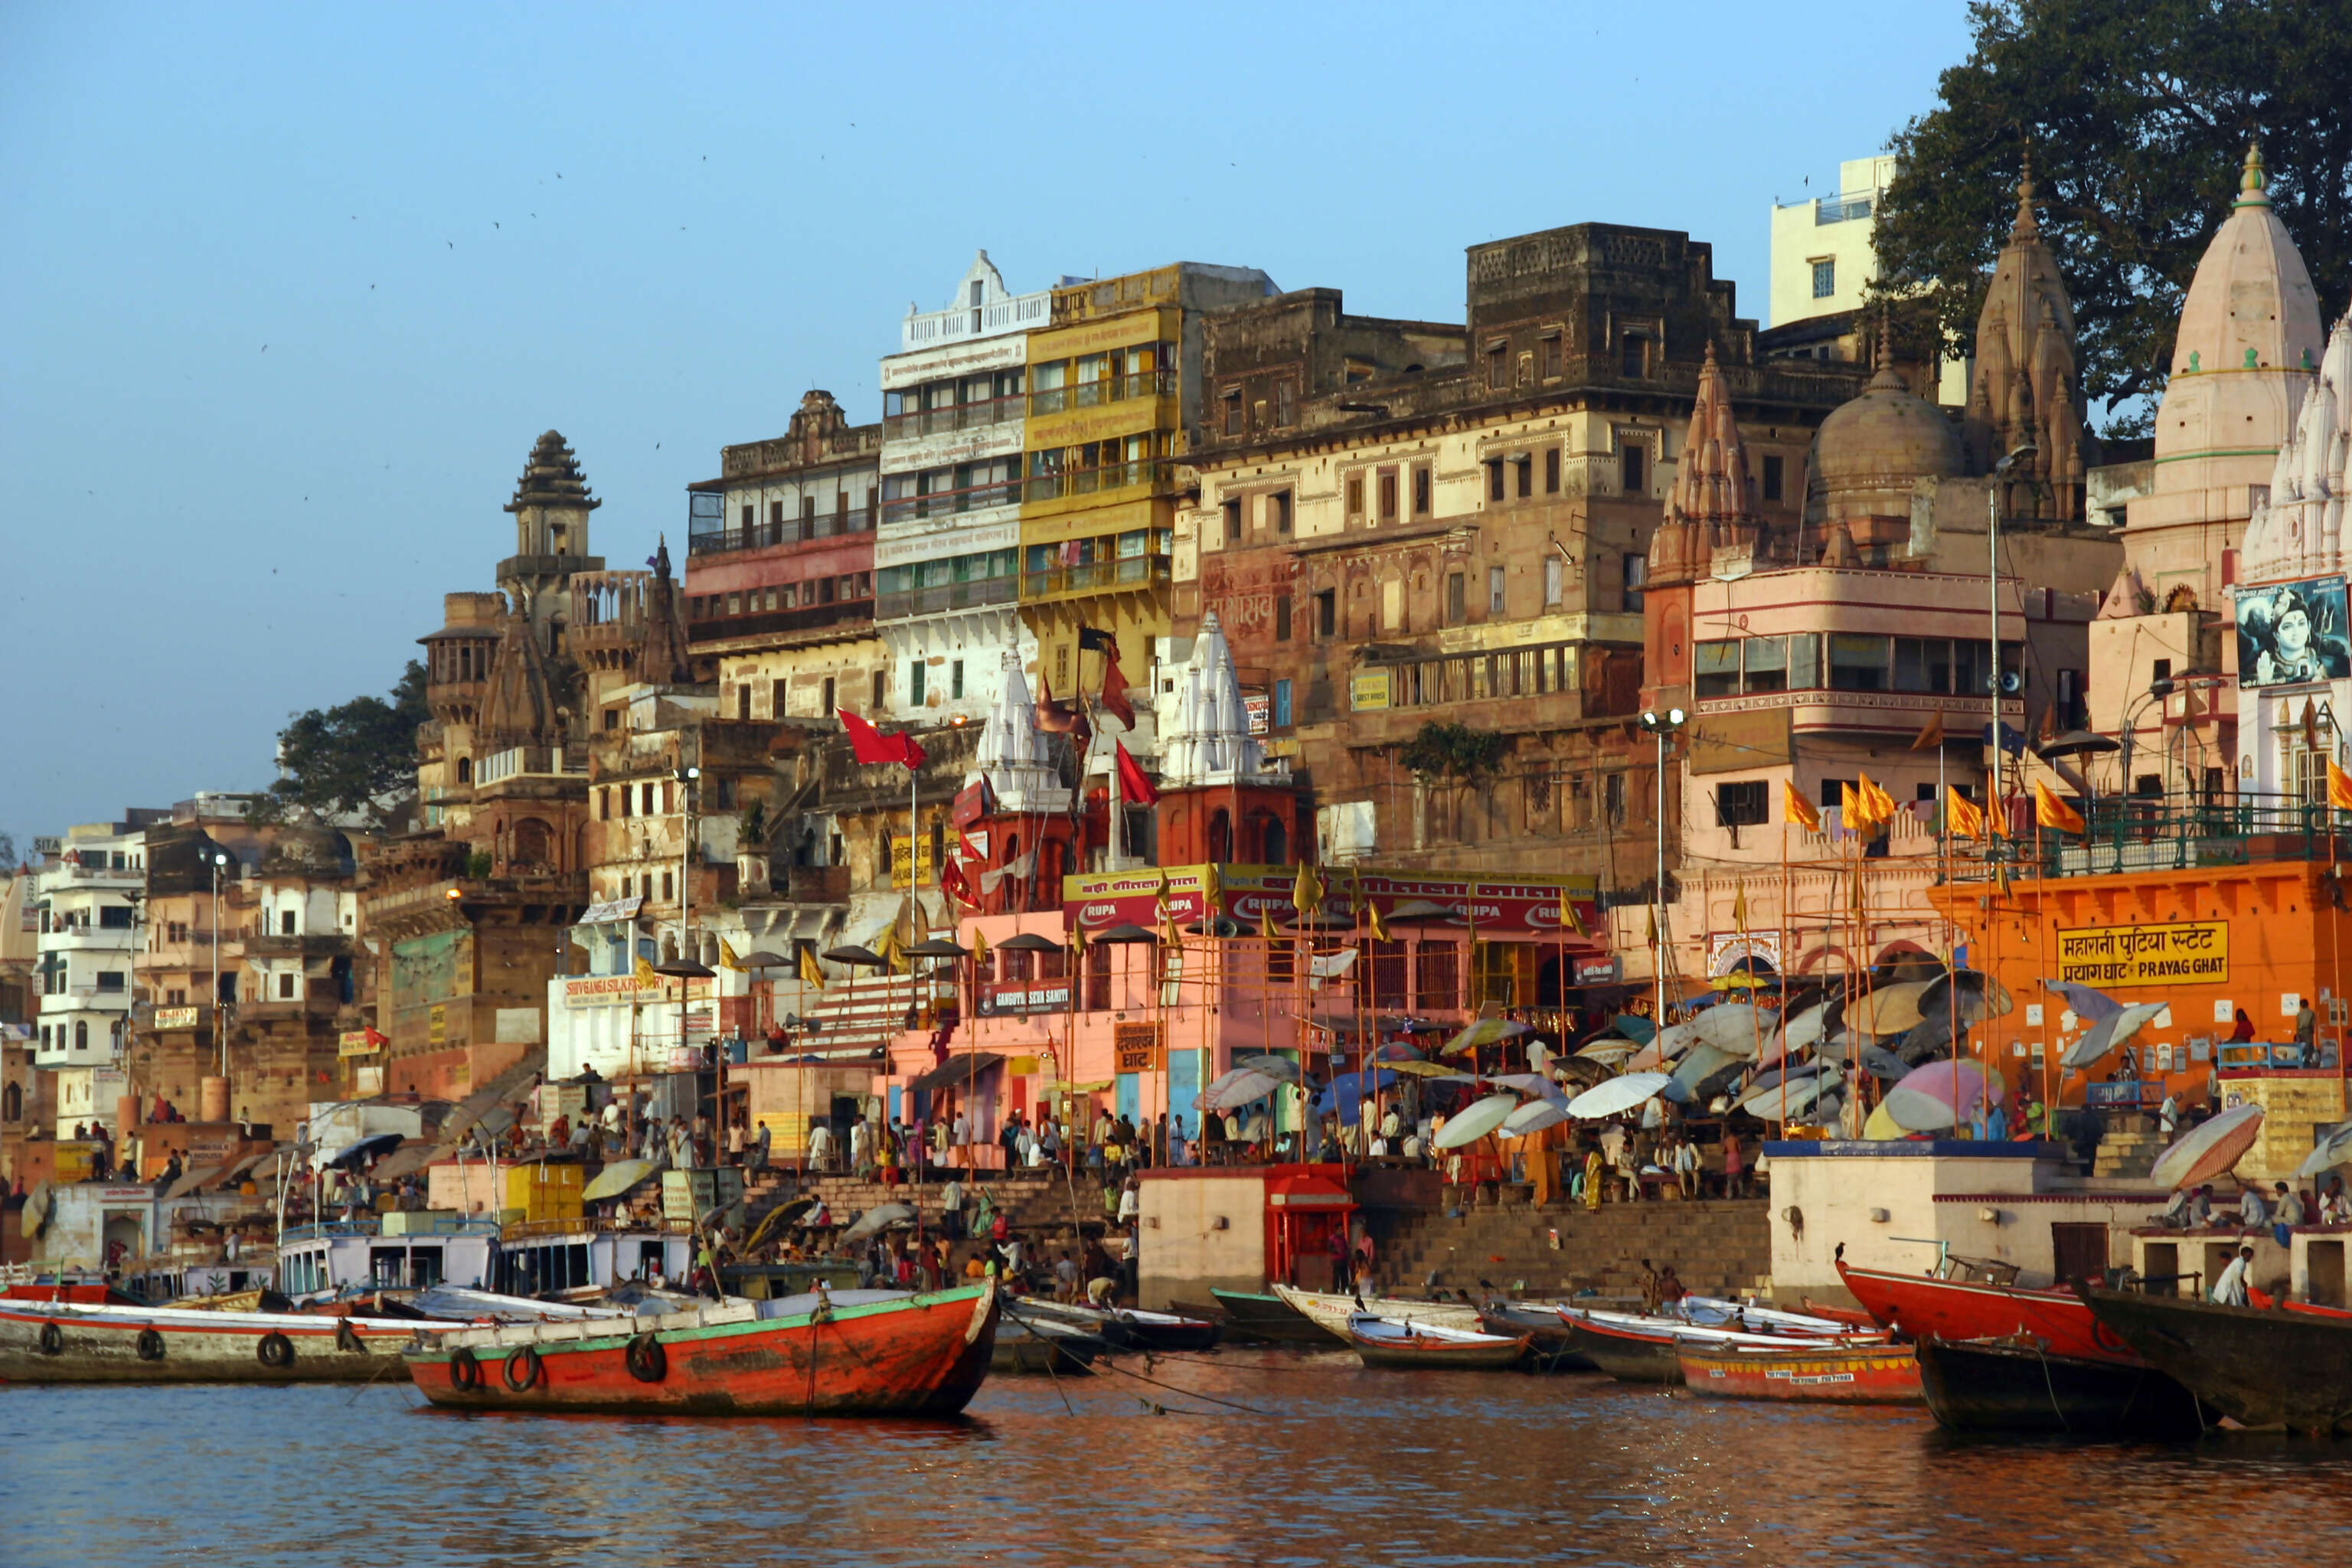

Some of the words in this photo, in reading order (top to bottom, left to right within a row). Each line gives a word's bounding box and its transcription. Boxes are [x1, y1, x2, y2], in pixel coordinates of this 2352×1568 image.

[35, 838, 61, 851] SITA
[1087, 905, 1116, 917] RUPA
[1248, 897, 1294, 910] RUPA
[2063, 929, 2115, 962] महारानी
[2118, 926, 2167, 962] पुटिया
[2171, 923, 2216, 953] स्टेट
[2063, 963, 2102, 983] प्रयाग
[2104, 962, 2128, 981] घाट
[2138, 959, 2190, 978] PRAYAG
[2193, 957, 2225, 974] GHAT
[607, 978, 627, 993] SILK
[1028, 991, 1044, 1004] SEVA
[1046, 988, 1068, 1003] SAMITI
[1122, 1052, 1148, 1068] घाट
